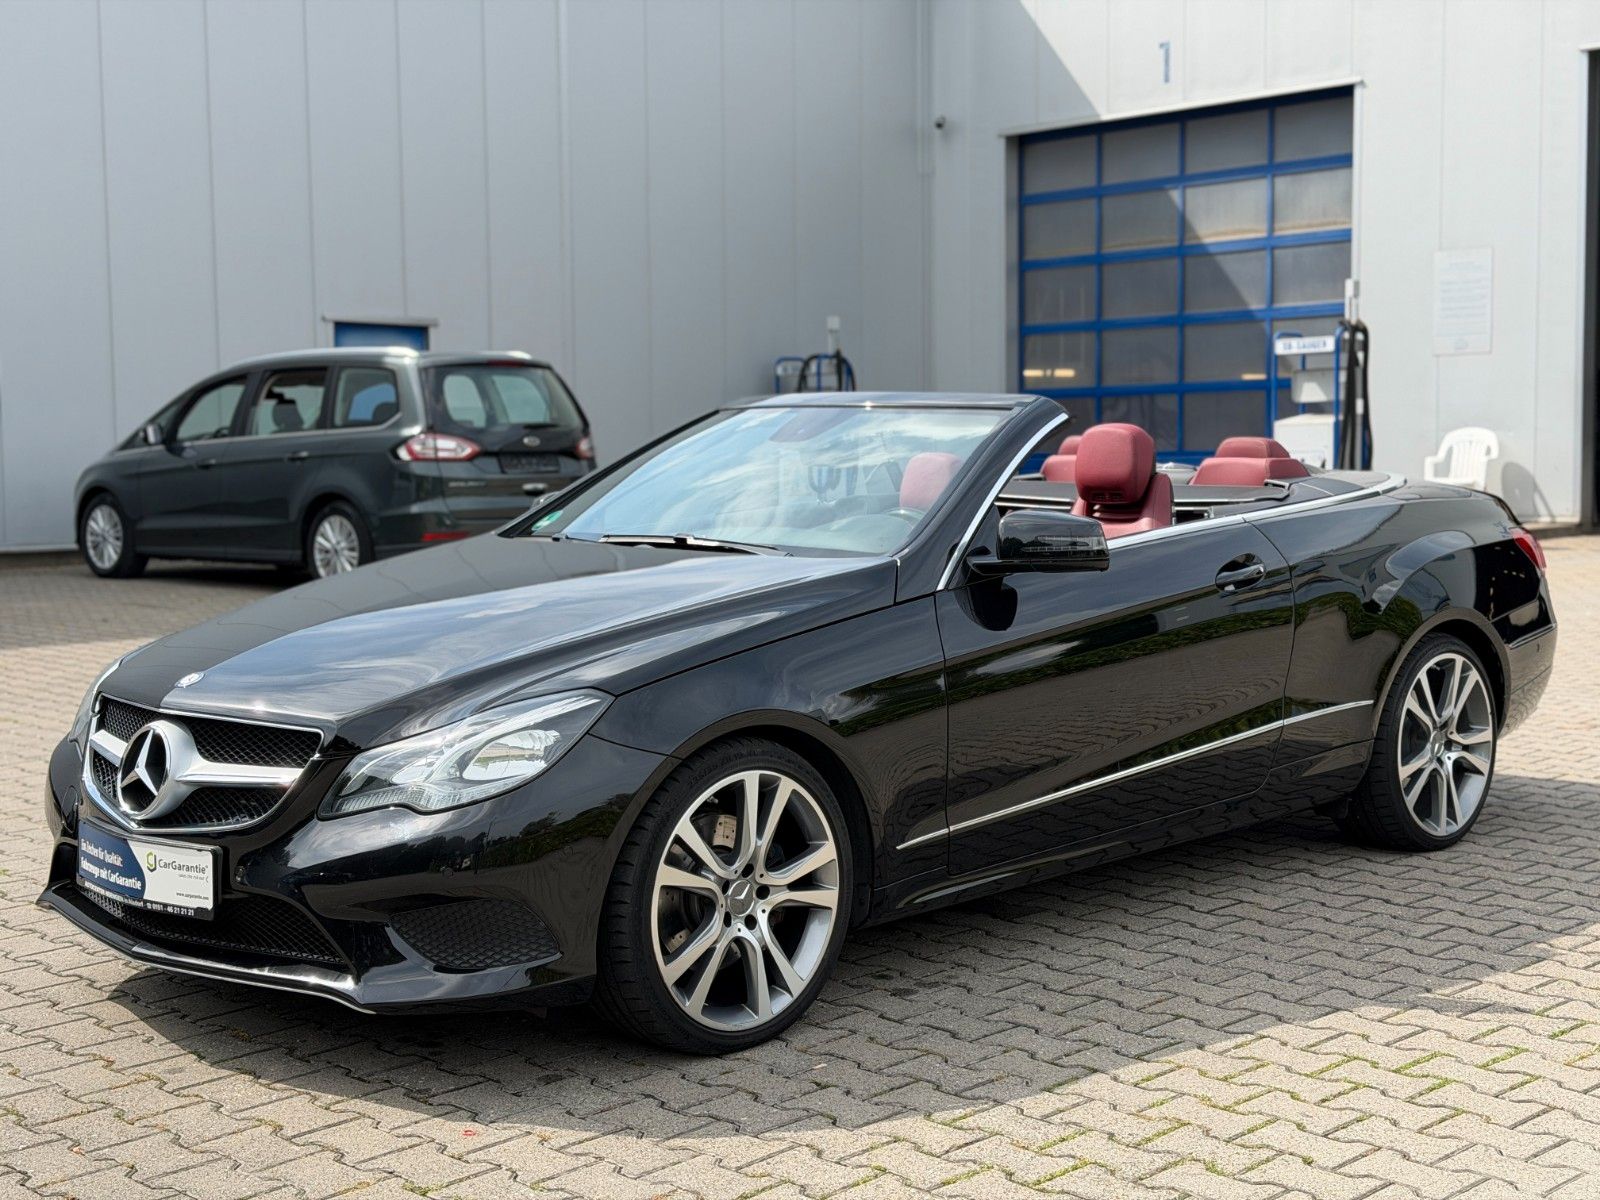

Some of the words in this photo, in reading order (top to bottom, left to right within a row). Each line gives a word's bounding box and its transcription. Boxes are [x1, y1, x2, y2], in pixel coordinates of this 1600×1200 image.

[1159, 42, 1170, 83] 1
[108, 869, 142, 890] CarGarantie
[173, 906, 180, 914] 21
